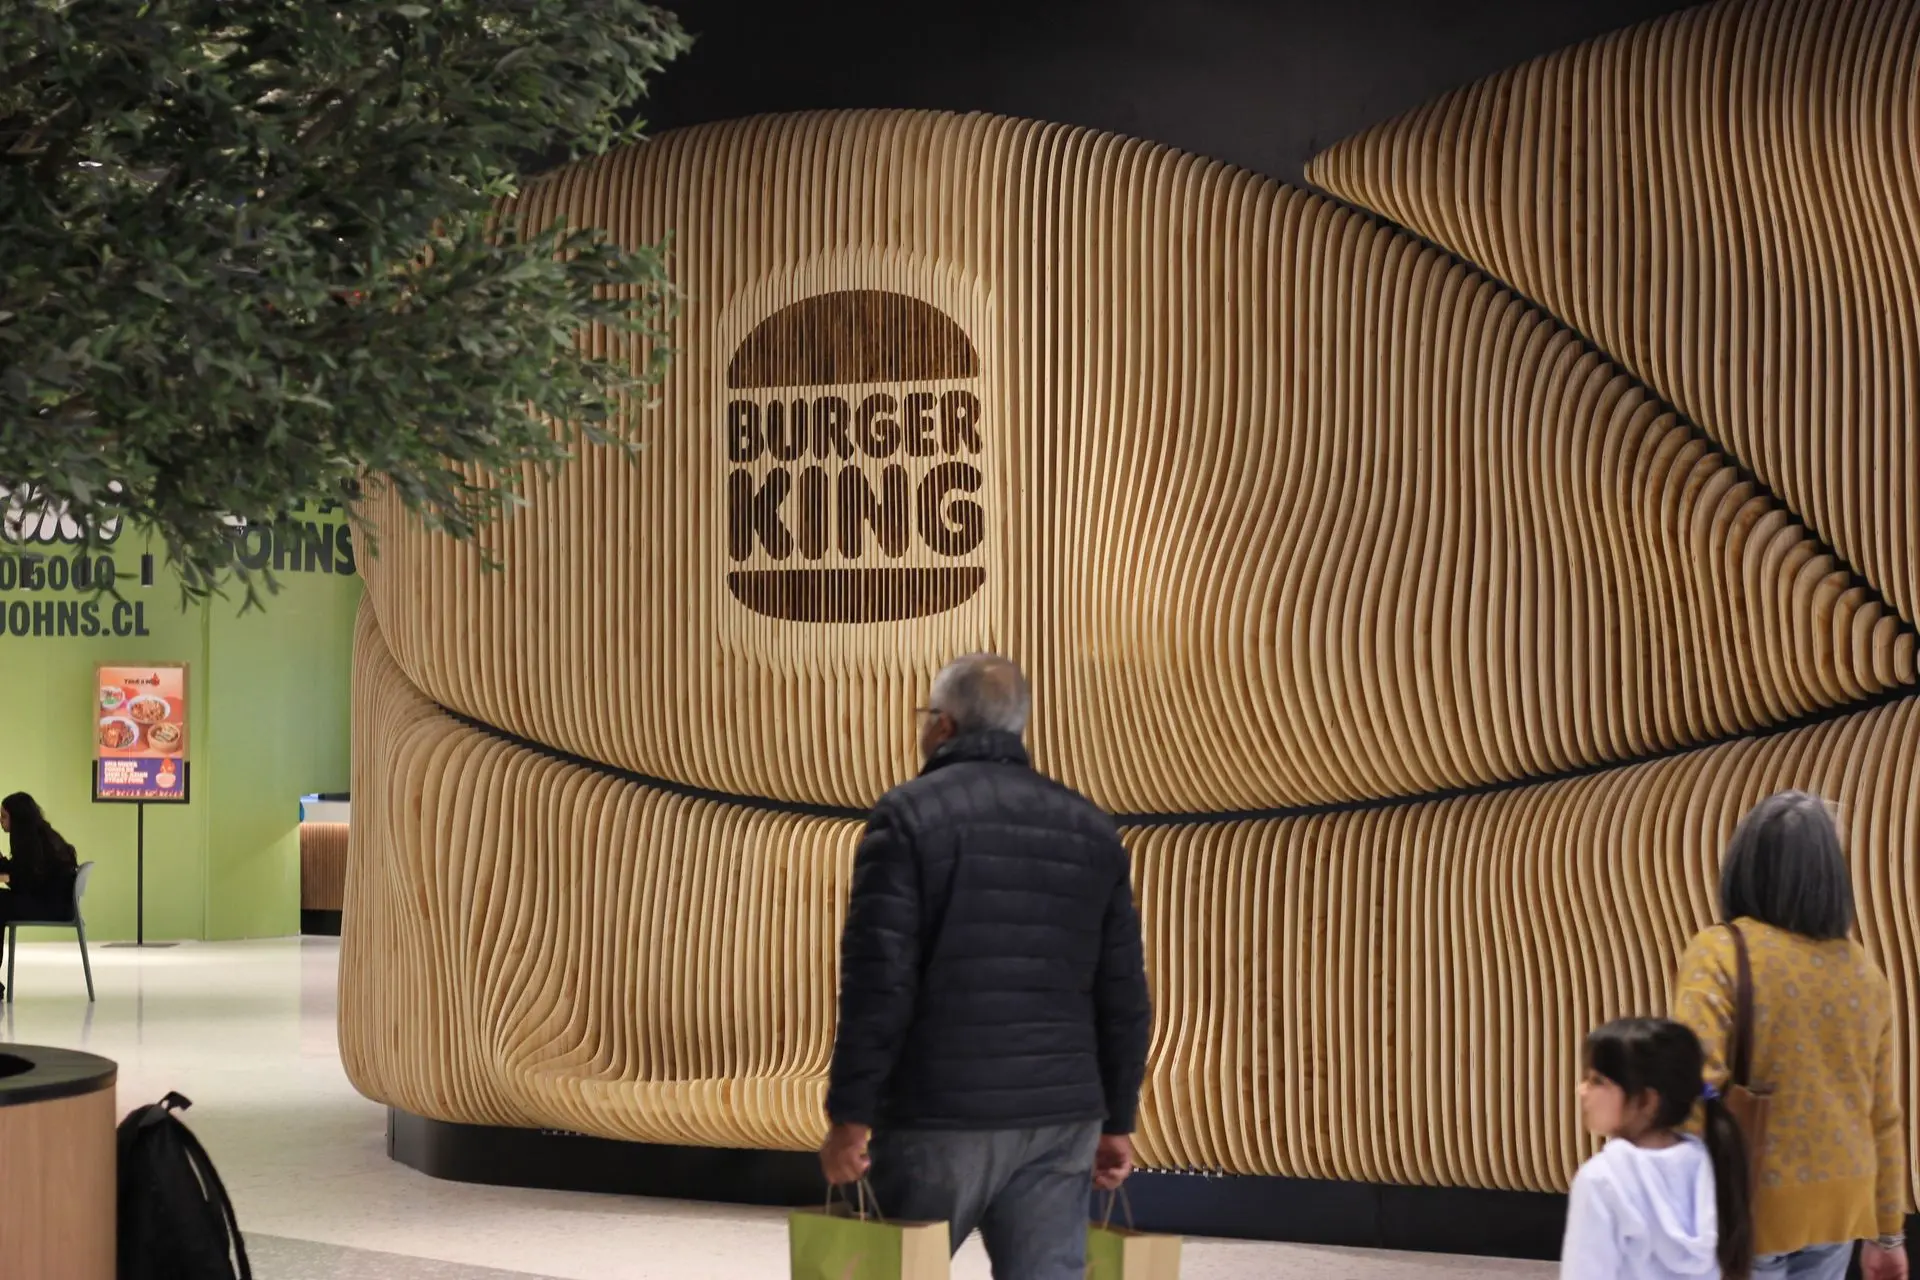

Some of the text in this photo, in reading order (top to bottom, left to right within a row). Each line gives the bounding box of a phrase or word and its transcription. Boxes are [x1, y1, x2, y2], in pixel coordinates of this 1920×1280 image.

[728, 390, 983, 464] BURGER
[216, 519, 356, 576] OHNS
[728, 461, 985, 562] KING
